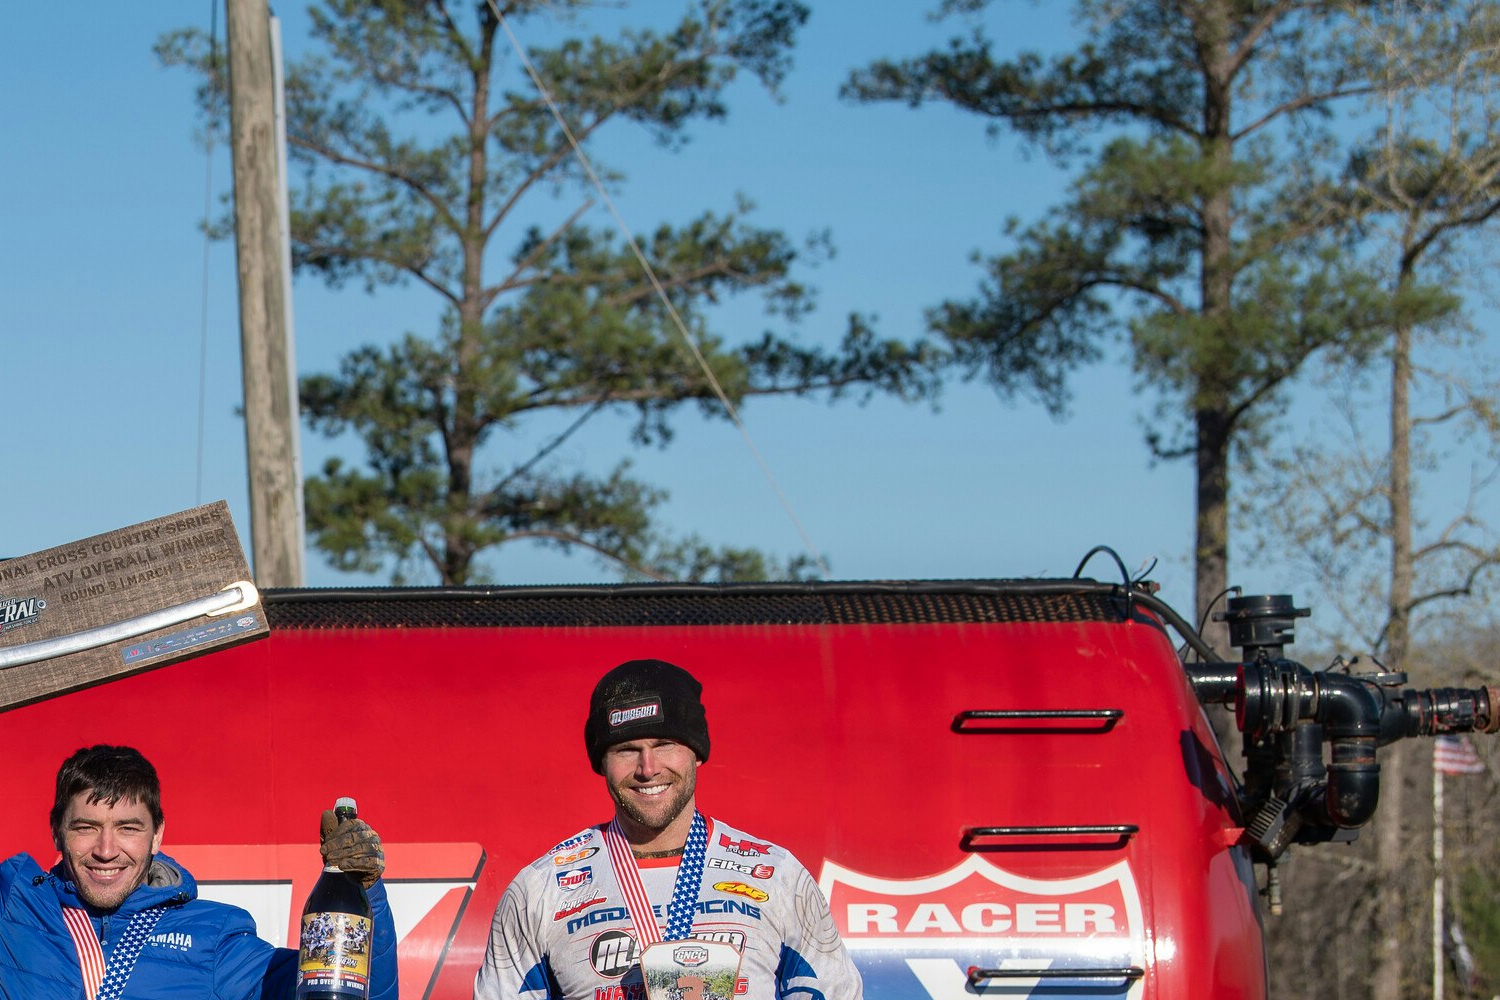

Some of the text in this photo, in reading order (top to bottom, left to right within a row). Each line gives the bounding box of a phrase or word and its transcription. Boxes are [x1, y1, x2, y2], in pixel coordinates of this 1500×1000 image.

[36, 546, 89, 573] CROSS
[91, 526, 161, 554] COUNTRY
[165, 509, 222, 535] SERIES
[41, 527, 228, 592] ATV OVERALL WINNER
[60, 580, 106, 604] ROUND
[126, 564, 171, 586] MARCH
[554, 849, 590, 866] CST
[707, 858, 754, 875] Elka
[560, 871, 591, 887] DWT
[713, 881, 770, 902] FMF
[566, 906, 663, 935] MOOE
[667, 899, 762, 920] ACING
[845, 902, 1116, 934] RACER
[148, 932, 192, 948] AMAHA
[675, 951, 707, 960] GNCC
[307, 978, 365, 991] PRO OVERLL WINNER
